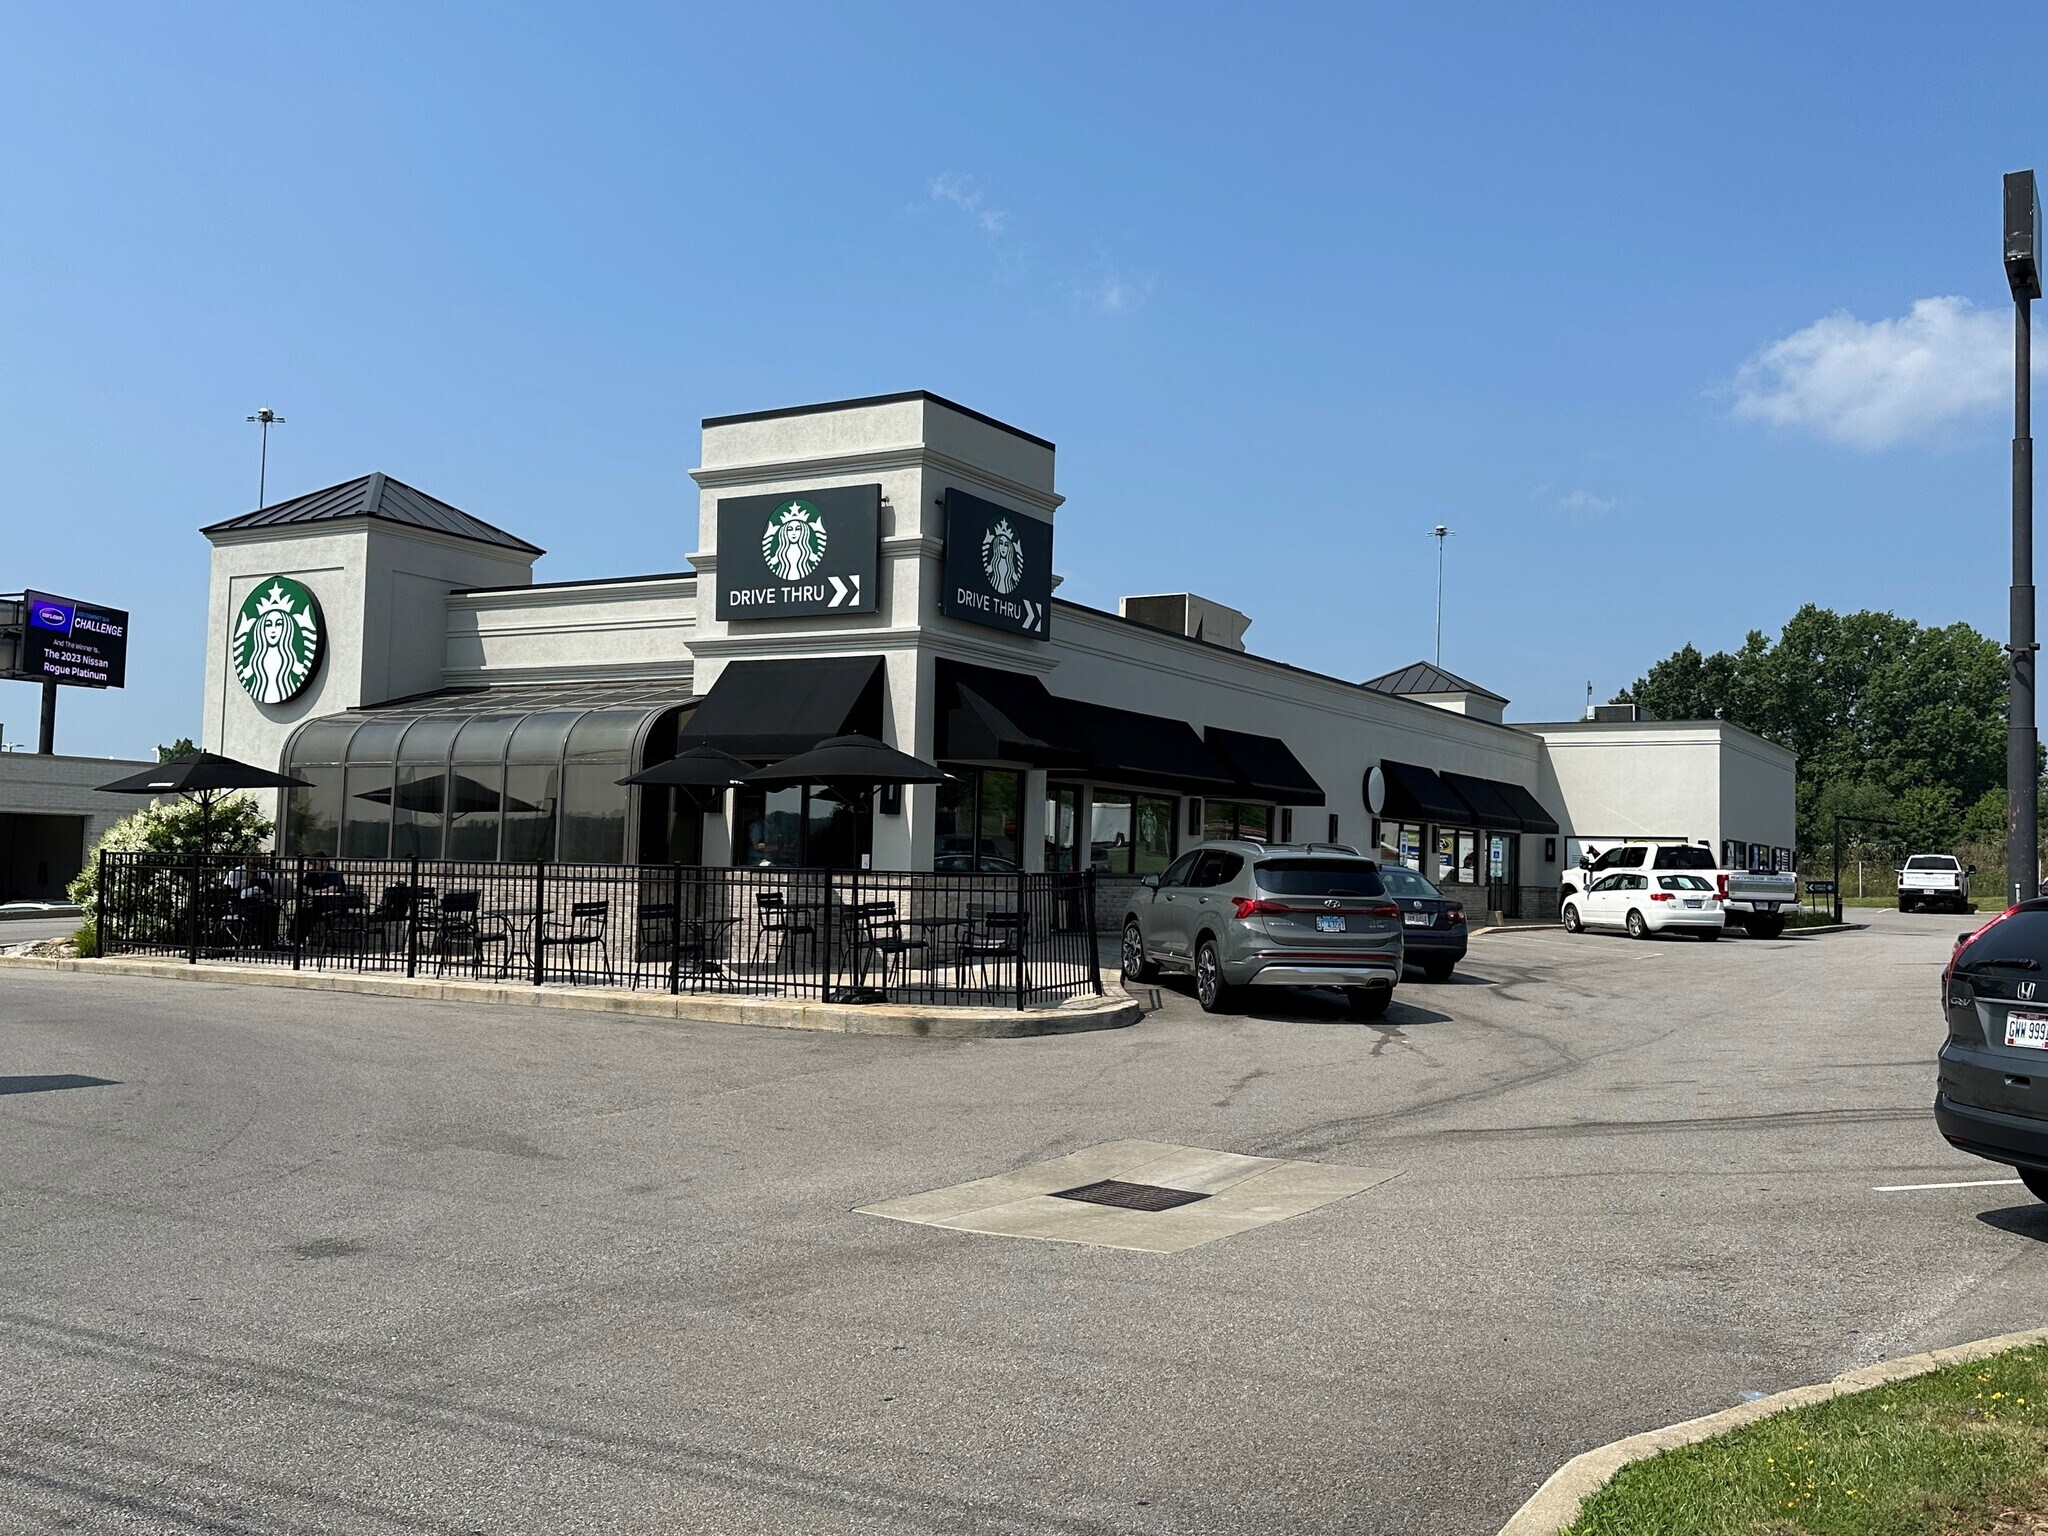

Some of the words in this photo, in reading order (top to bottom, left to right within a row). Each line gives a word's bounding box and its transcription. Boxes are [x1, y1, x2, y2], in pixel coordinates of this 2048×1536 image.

[729, 588, 776, 606] DRIVE
[780, 584, 825, 603] THRU
[957, 588, 990, 611] DRIVE
[993, 598, 1021, 619] THRU
[42, 612, 62, 621] cars.com
[74, 617, 124, 637] CHALLENGE
[53, 639, 64, 647] And
[65, 640, 75, 649] The
[75, 642, 93, 652] Winner
[43, 648, 60, 660] The
[60, 651, 81, 663] 2023
[82, 655, 109, 668] Nissan
[43, 662, 71, 675] Rogue
[71, 666, 107, 681] Platinum
